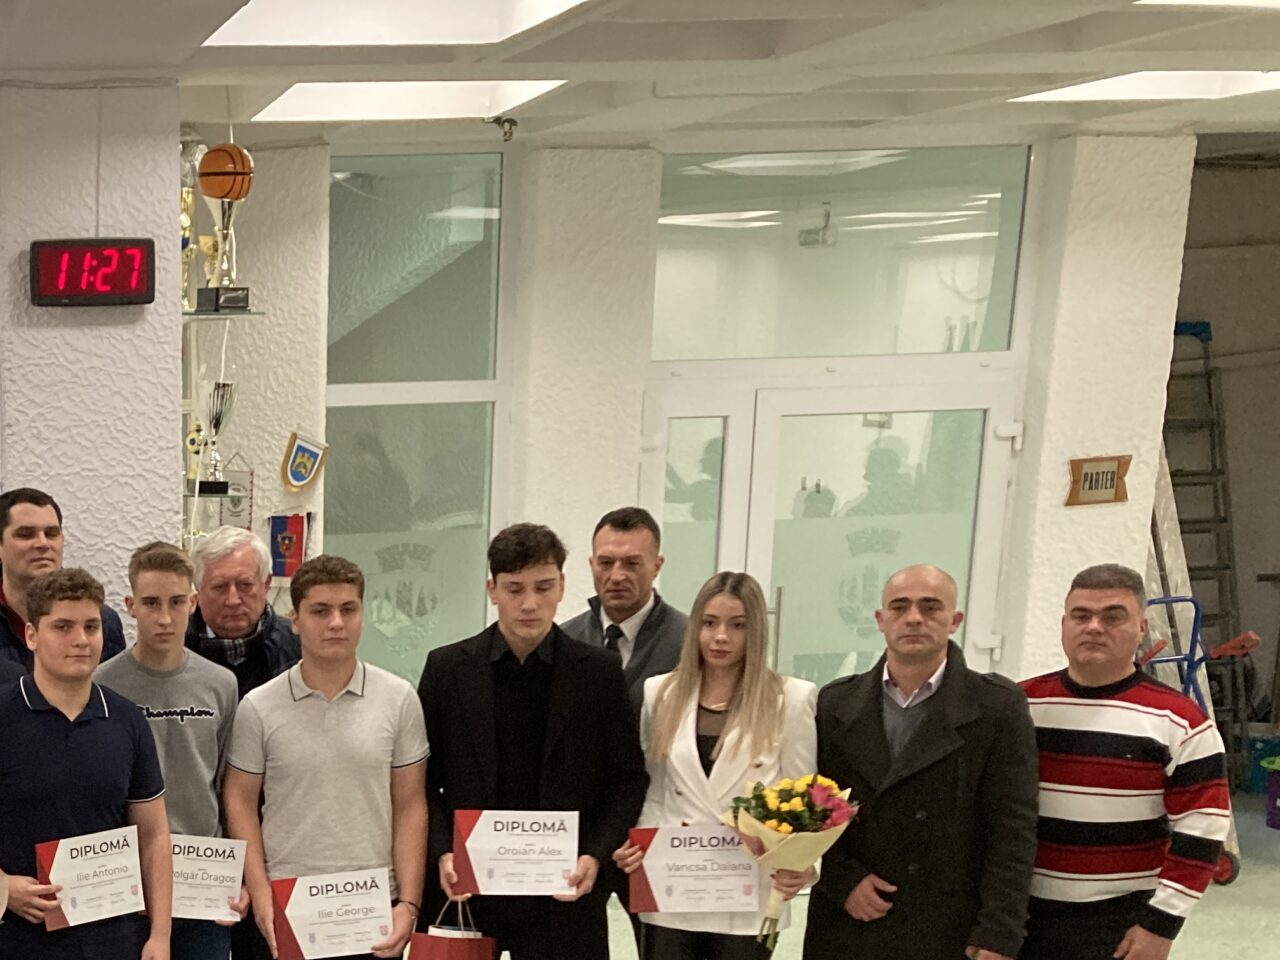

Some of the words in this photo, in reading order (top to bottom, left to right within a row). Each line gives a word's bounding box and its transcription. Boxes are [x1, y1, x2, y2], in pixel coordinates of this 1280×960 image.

[57, 247, 142, 292] 11:27
[1082, 470, 1116, 491] PARTER
[494, 819, 568, 833] DIPLOMĂ
[69, 834, 131, 860] DIPLOMĂ
[172, 844, 236, 861] DIPLOMĂ
[538, 846, 562, 856] Alex
[92, 865, 129, 881] Antonio
[172, 869, 199, 881] olgár
[309, 876, 380, 897] DIPLOMĂ
[335, 906, 376, 917] George
